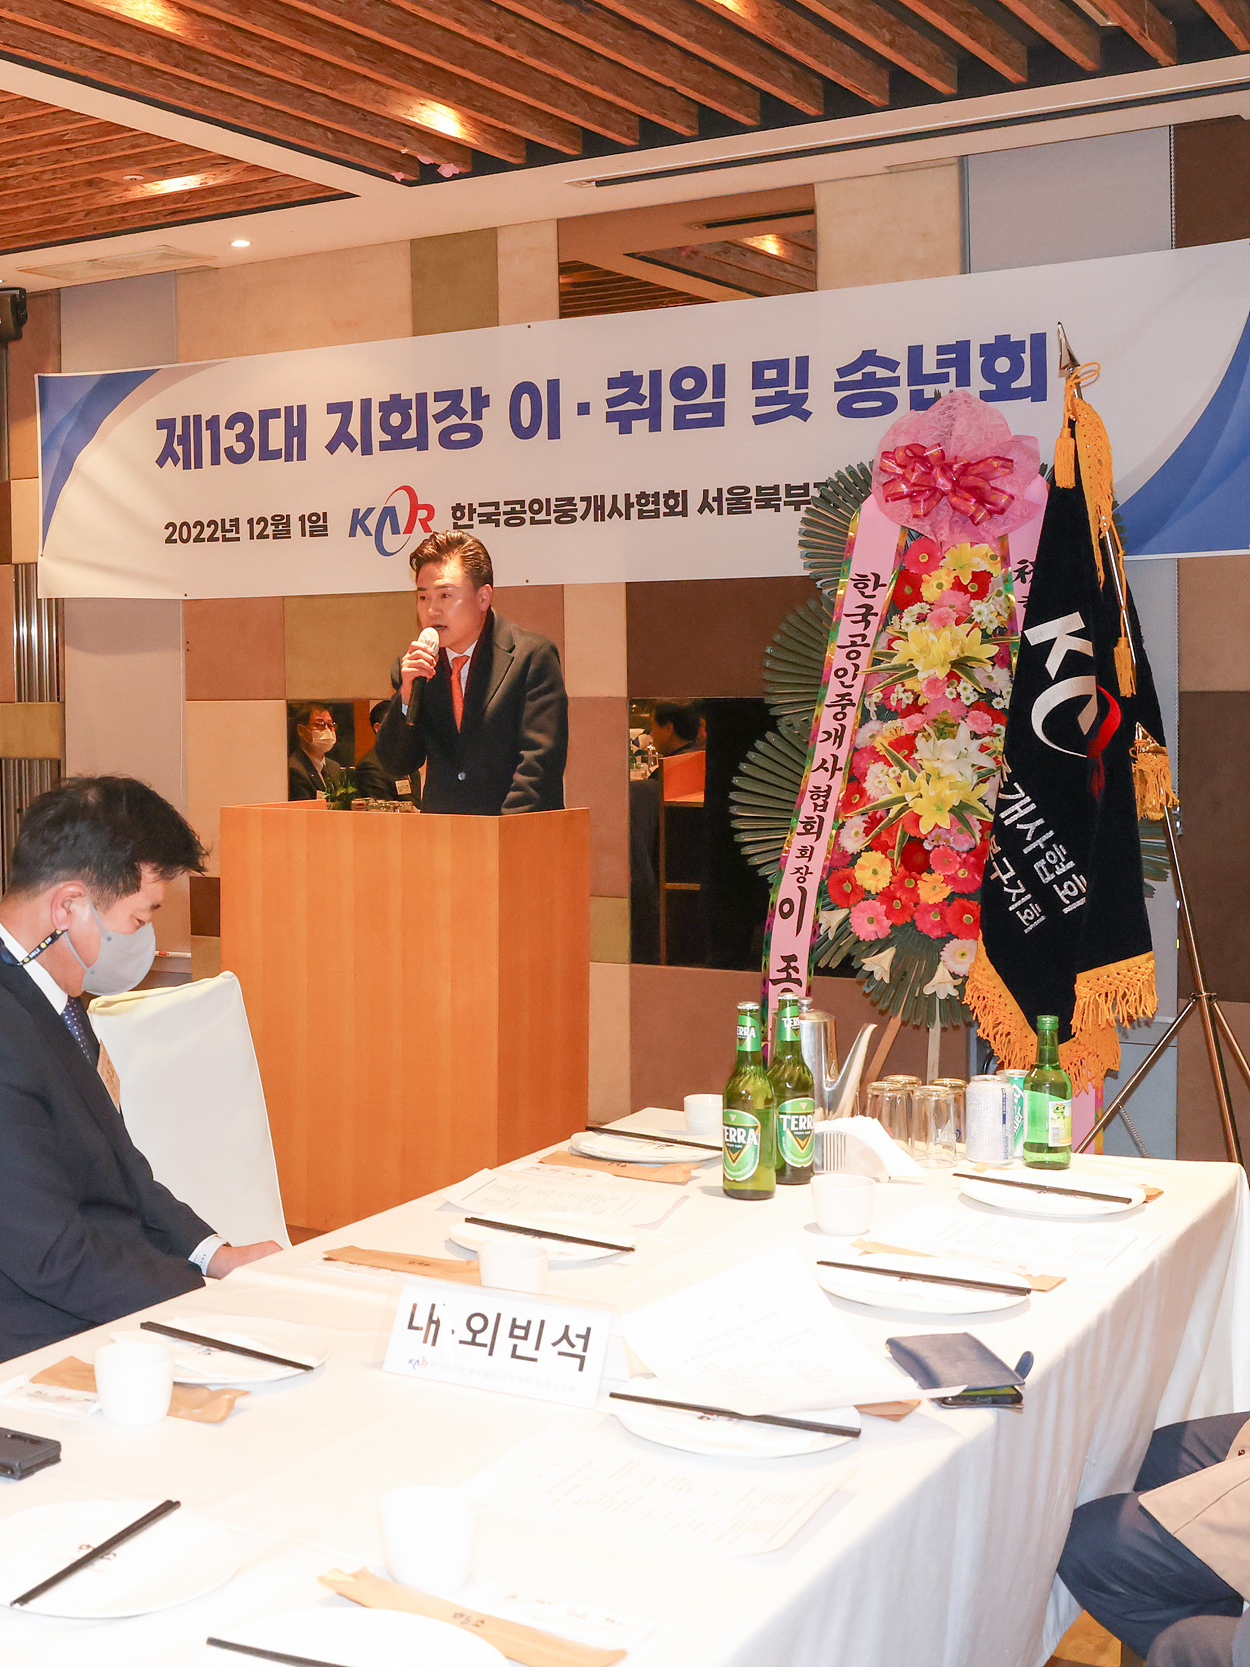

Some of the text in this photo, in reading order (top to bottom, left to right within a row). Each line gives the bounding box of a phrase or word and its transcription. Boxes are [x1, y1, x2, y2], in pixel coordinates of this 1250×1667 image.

[155, 404, 307, 471] 제13대
[324, 386, 491, 456] 지회장
[751, 355, 812, 426] 및
[834, 332, 1047, 418] 송년회
[450, 481, 828, 531] 한국공인중개사협회 서울북부
[164, 511, 329, 544] 2022년 12월 1일
[736, 1025, 756, 1038] ERRA
[723, 1125, 758, 1146] ERRA
[779, 1114, 813, 1131] TERR
